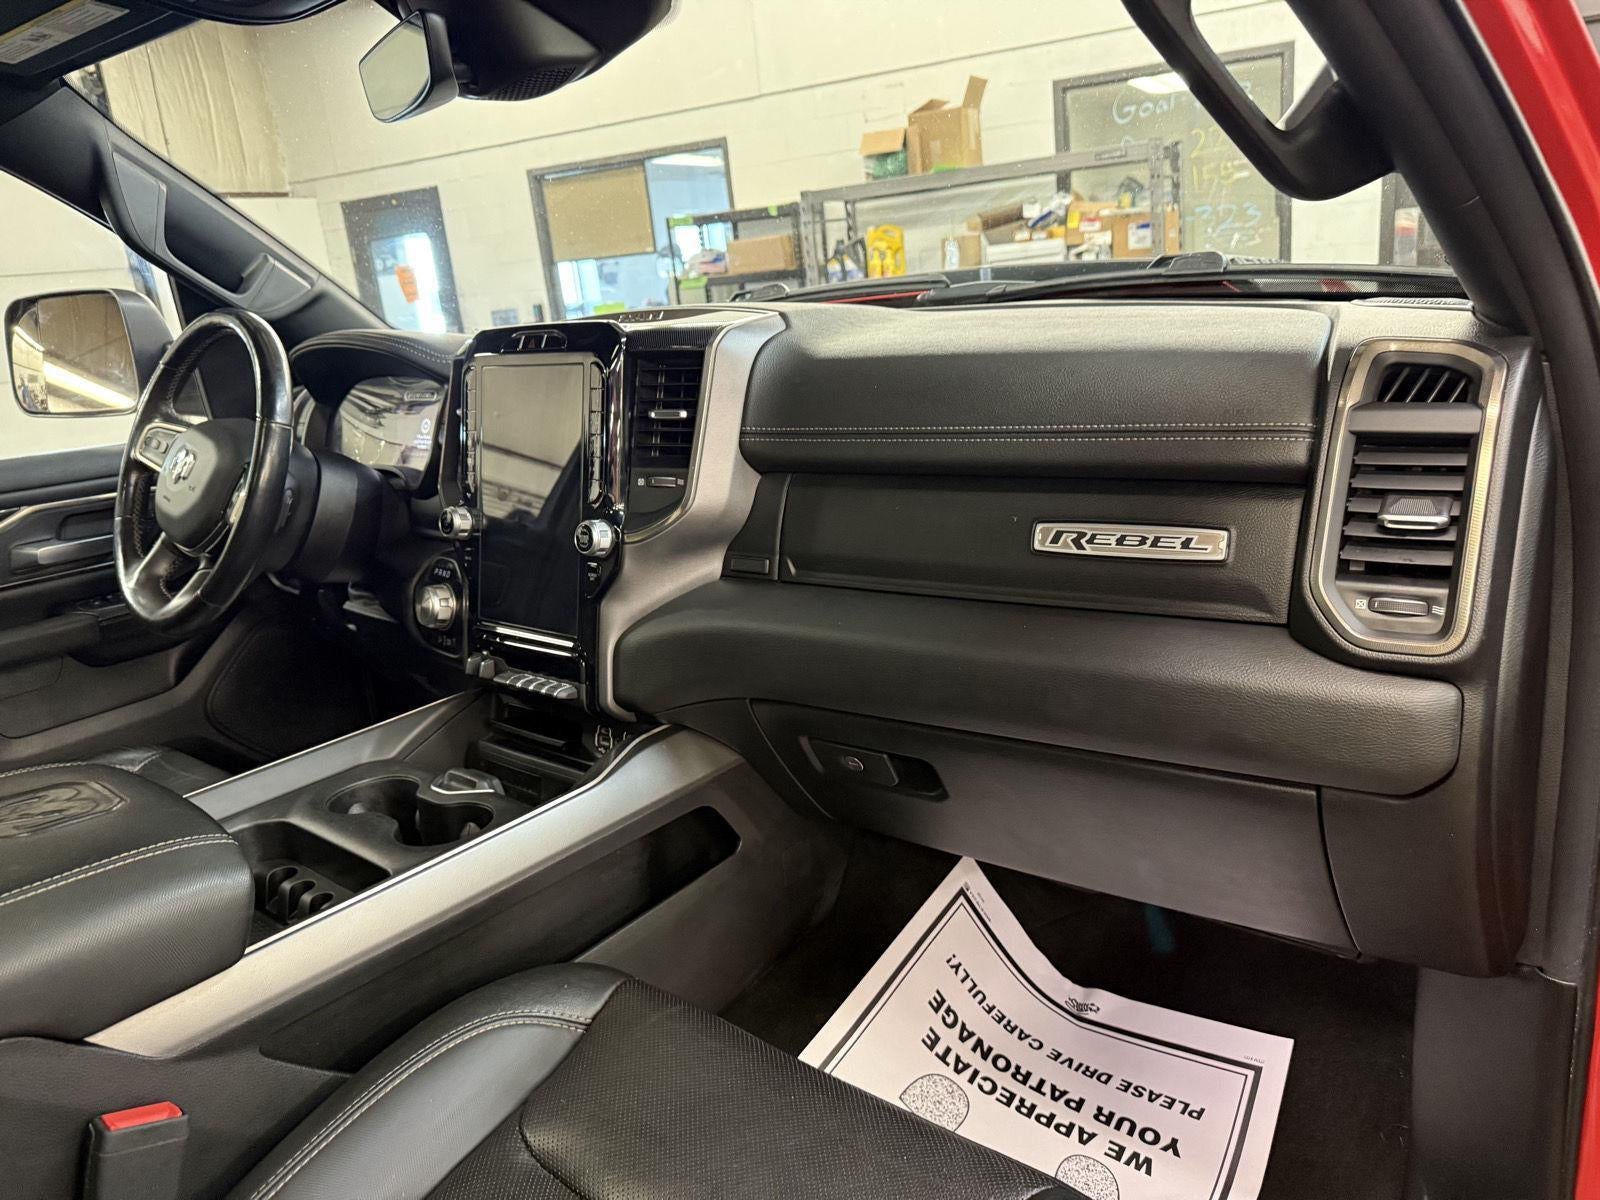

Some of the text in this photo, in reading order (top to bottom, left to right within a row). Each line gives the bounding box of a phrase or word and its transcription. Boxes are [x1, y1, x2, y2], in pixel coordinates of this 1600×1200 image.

[1045, 529, 1211, 551] REBEL
[945, 953, 1045, 1051] CAREFULLY!
[921, 1026, 1153, 1177] WE APPRECIATE
[928, 989, 1181, 1159] YOUR PATRONAGE
[1046, 1048, 1114, 1086] DRIVE
[1115, 1078, 1206, 1121] PLEASE
